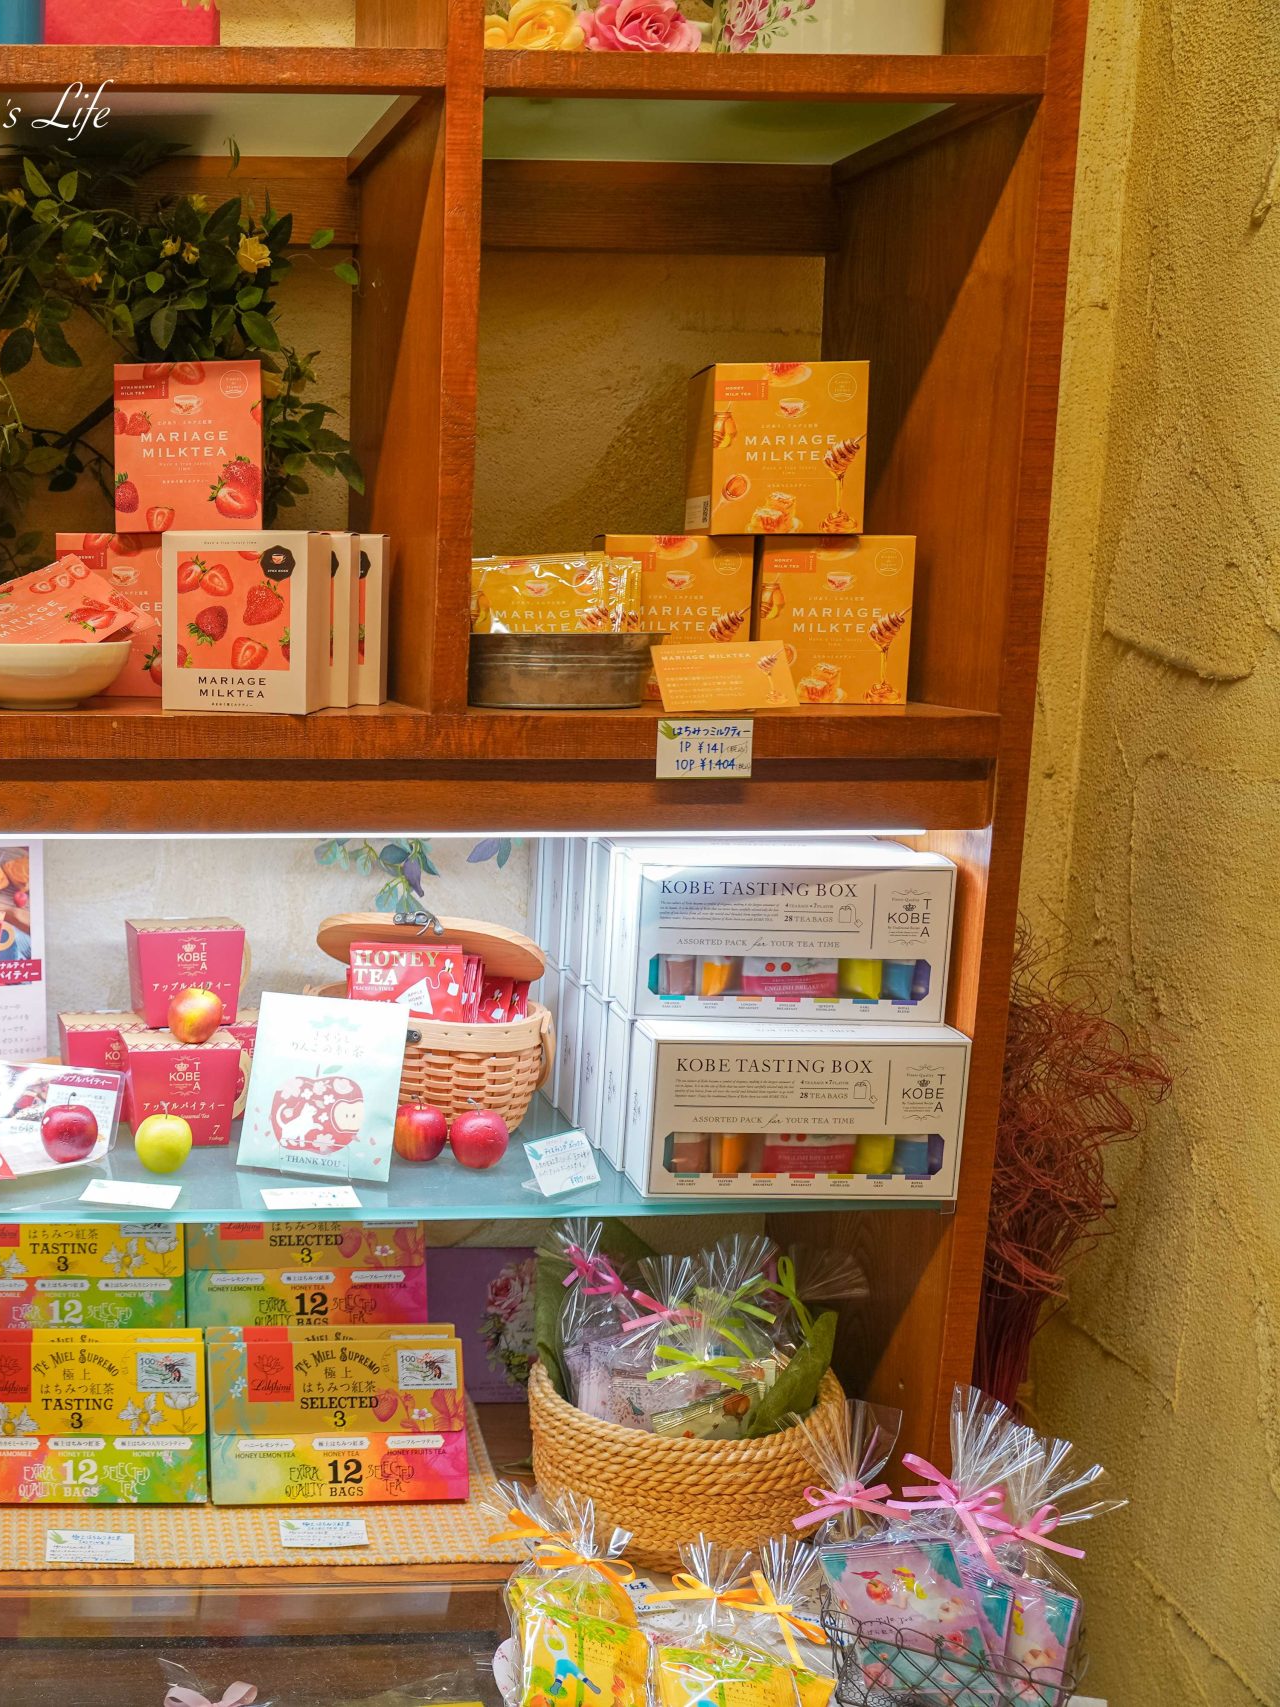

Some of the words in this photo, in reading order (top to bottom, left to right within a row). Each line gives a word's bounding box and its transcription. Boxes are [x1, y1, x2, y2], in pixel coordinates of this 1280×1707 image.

[140, 430, 229, 443] MARIAGE
[745, 434, 837, 445] MARIAGE
[142, 446, 227, 458] MILKTEA
[746, 450, 833, 461] MILKTEA
[495, 608, 584, 620] MARIAGE
[792, 607, 882, 618] MARIAGE
[792, 623, 879, 633] MILKTEA
[661, 654, 705, 662] MARIAGE
[708, 652, 751, 660] MILKTEA
[198, 676, 267, 686] MARIAGE
[199, 689, 265, 699] MILKTEA
[672, 726, 751, 736] はちみつミルクティー
[698, 741, 723, 753] ¥141
[676, 759, 694, 771] 10P
[660, 879, 715, 896] KOBE
[720, 881, 810, 897] TASTING
[815, 883, 859, 898] BOX
[677, 938, 723, 946] ASSORTED
[177, 953, 207, 962] KOBE
[354, 949, 441, 967] HONEY
[353, 968, 399, 985] TEA
[676, 1058, 731, 1073] KOBE
[735, 1058, 825, 1073] TASTING
[830, 1059, 873, 1074] BOX
[169, 1072, 201, 1082] KOBE
[143, 1101, 225, 1110] アップルパイティー
[692, 1116, 738, 1124] ASSORTED
[740, 1116, 763, 1124] PACK
[785, 1116, 810, 1125] YOUR
[831, 1117, 855, 1125] TIME
[28, 1229, 99, 1240] はちみつ紅茶
[269, 1234, 344, 1247] SELECTED
[29, 1242, 98, 1255] TASTING
[301, 1248, 313, 1264] 3
[57, 1256, 69, 1272] 3
[295, 1292, 329, 1316] 12
[49, 1300, 83, 1323] 12
[312, 1350, 337, 1367] MIEL
[339, 1347, 381, 1376] SUPREMO
[62, 1368, 91, 1381] 極上
[324, 1367, 353, 1379] 極上
[40, 1382, 114, 1395] はちみつ紅茶
[302, 1381, 377, 1393] はちみつ紅茶
[41, 1398, 114, 1411] TASTING
[300, 1396, 379, 1410] SELECTED
[70, 1412, 83, 1429] 3
[333, 1411, 347, 1428] 3
[61, 1459, 99, 1485] 12
[328, 1458, 364, 1485] 12
[63, 1486, 100, 1498] BAGS
[329, 1486, 364, 1498] BAGS
